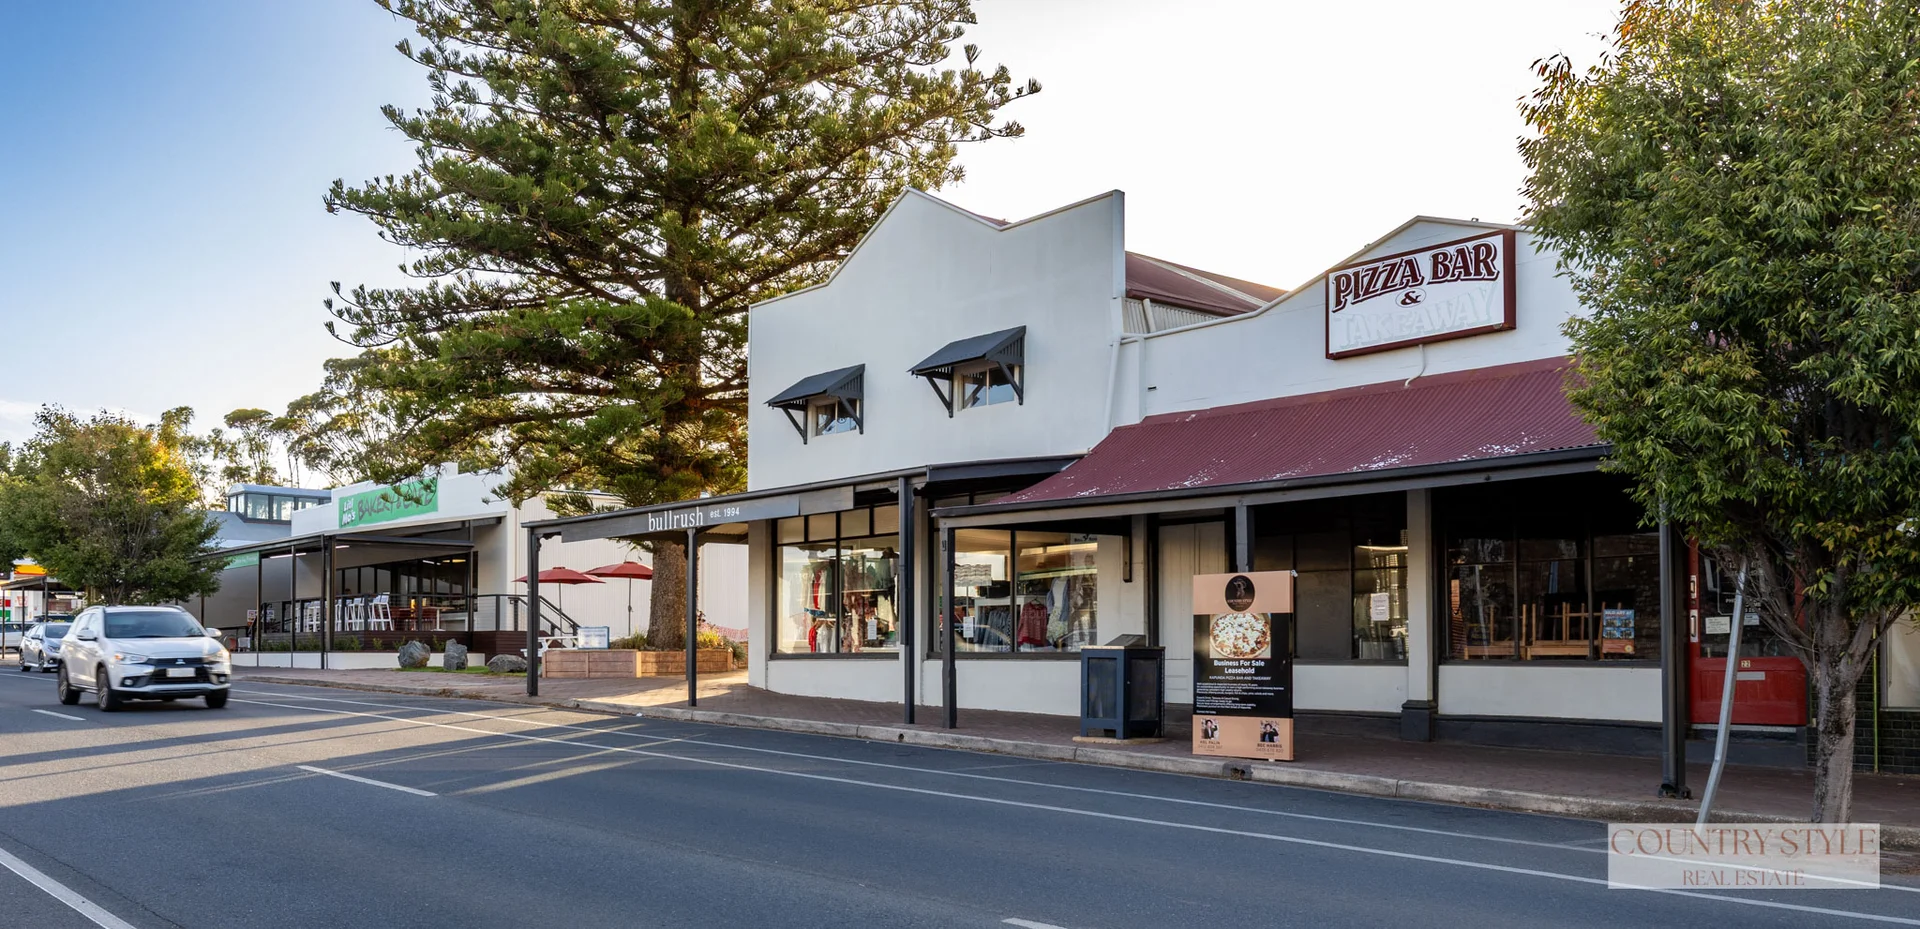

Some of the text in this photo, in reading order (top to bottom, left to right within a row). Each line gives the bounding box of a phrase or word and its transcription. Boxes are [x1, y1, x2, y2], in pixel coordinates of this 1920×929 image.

[1332, 240, 1500, 313] PIZZA BAR
[1400, 290, 1422, 306] &
[1334, 283, 1498, 349] TAKEAWAY
[648, 506, 740, 531] bullrush est. 1994
